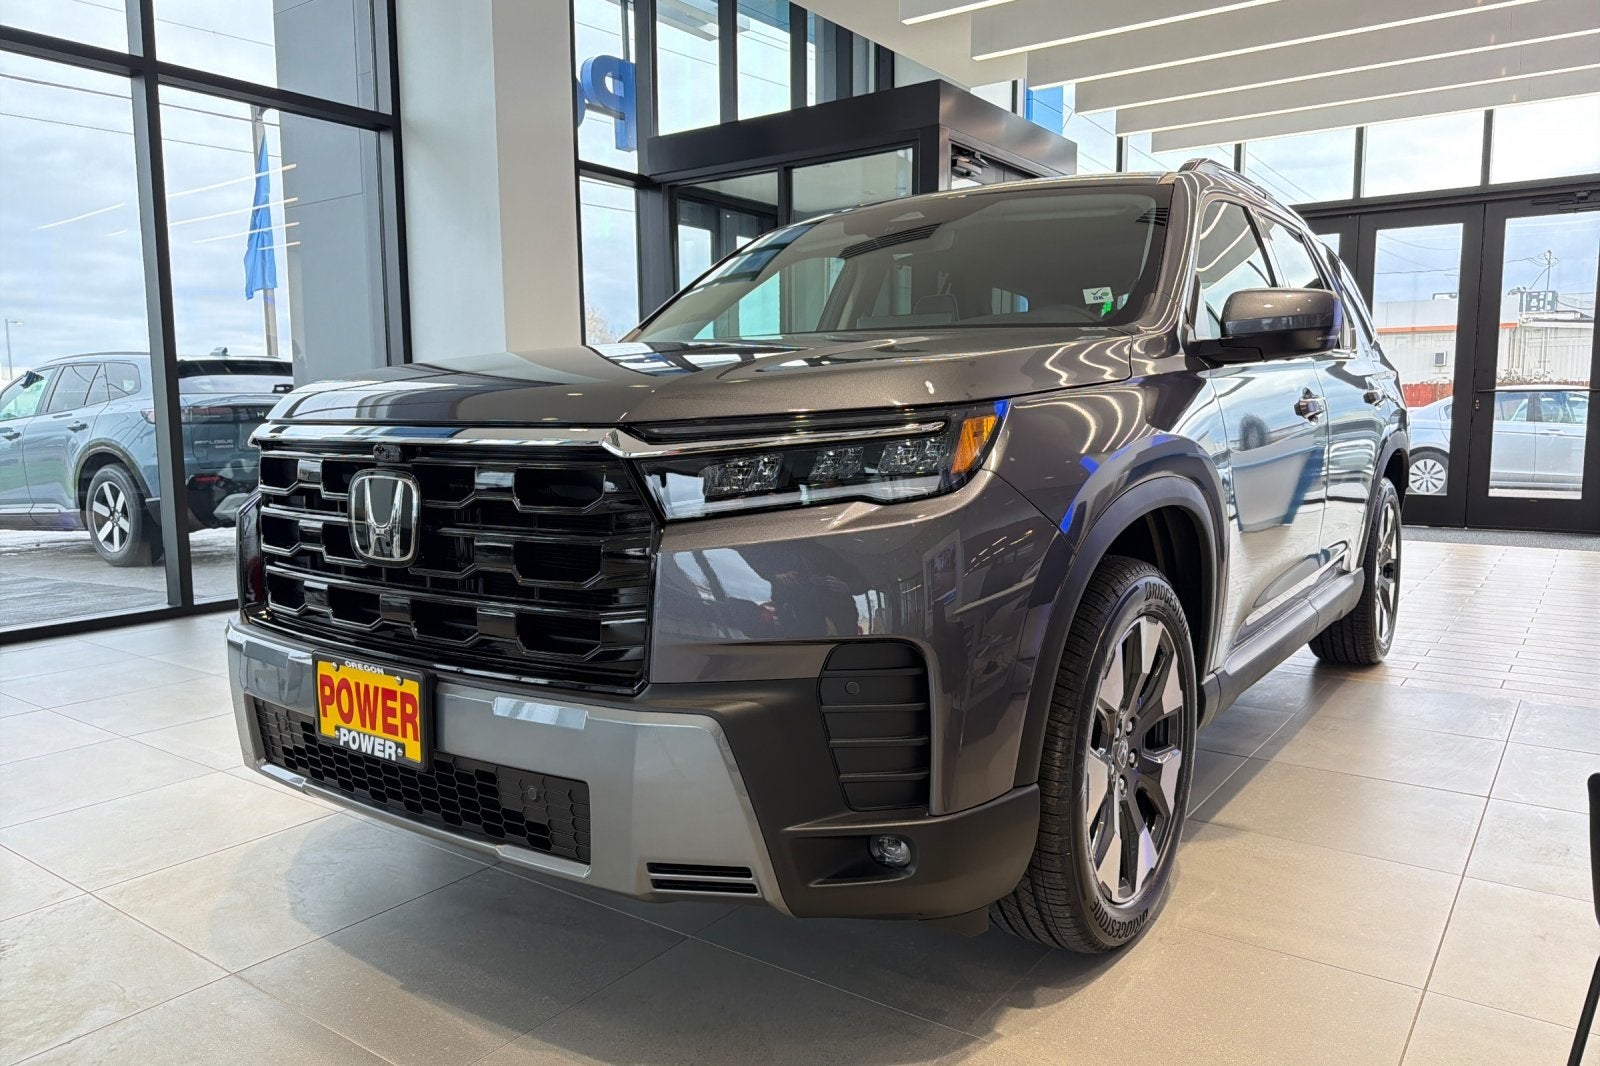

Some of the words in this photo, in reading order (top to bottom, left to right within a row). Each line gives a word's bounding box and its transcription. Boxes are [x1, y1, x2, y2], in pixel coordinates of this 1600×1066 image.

[1144, 581, 1189, 640] BRIDGESTONE
[344, 660, 385, 675] OREGON
[319, 673, 419, 742] POWER
[339, 727, 397, 761] POWER
